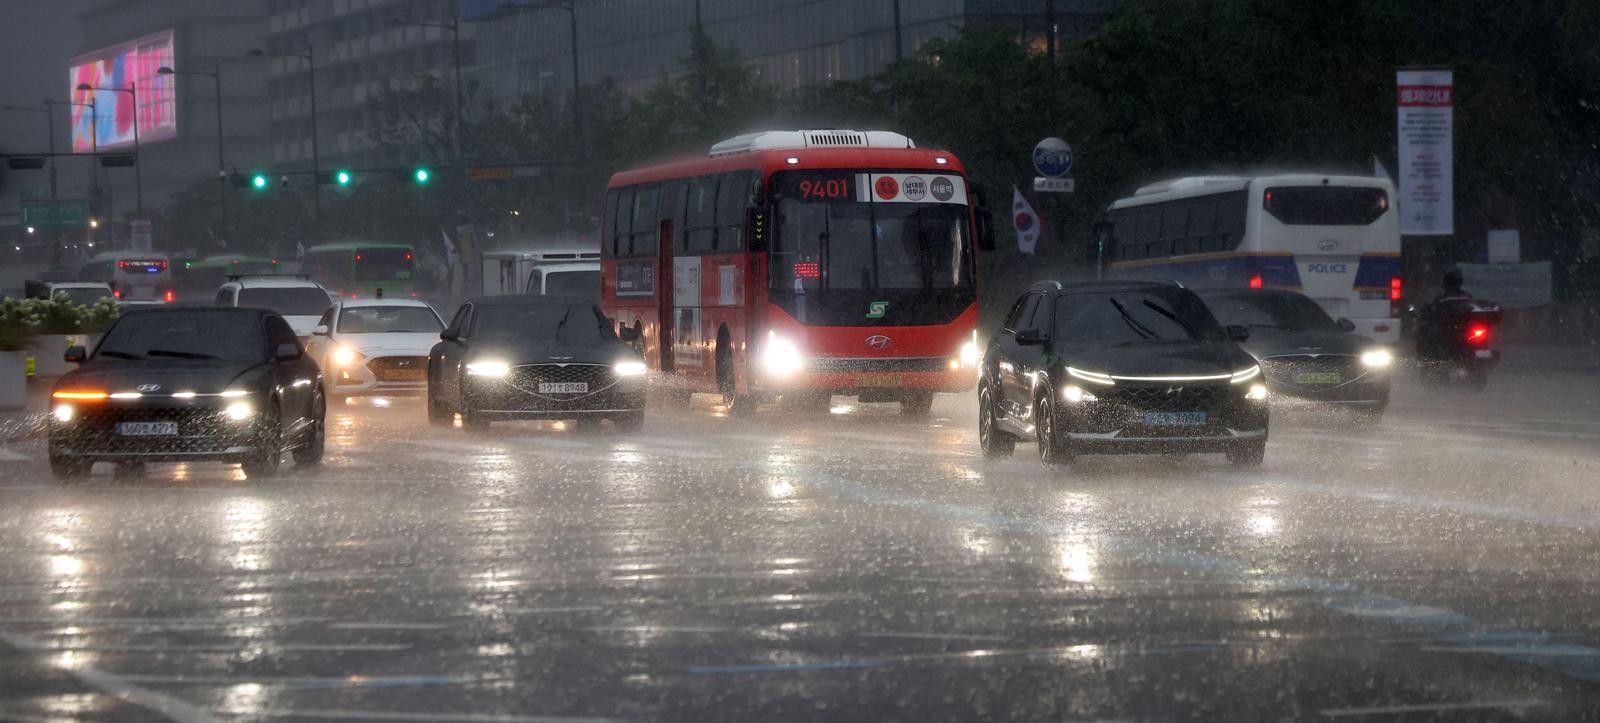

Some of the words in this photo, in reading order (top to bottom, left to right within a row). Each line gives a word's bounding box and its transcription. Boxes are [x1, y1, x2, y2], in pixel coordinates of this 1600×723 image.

[800, 179, 849, 199] 9401
[932, 185, 952, 194] 서울역
[1308, 263, 1348, 274] POLICE
